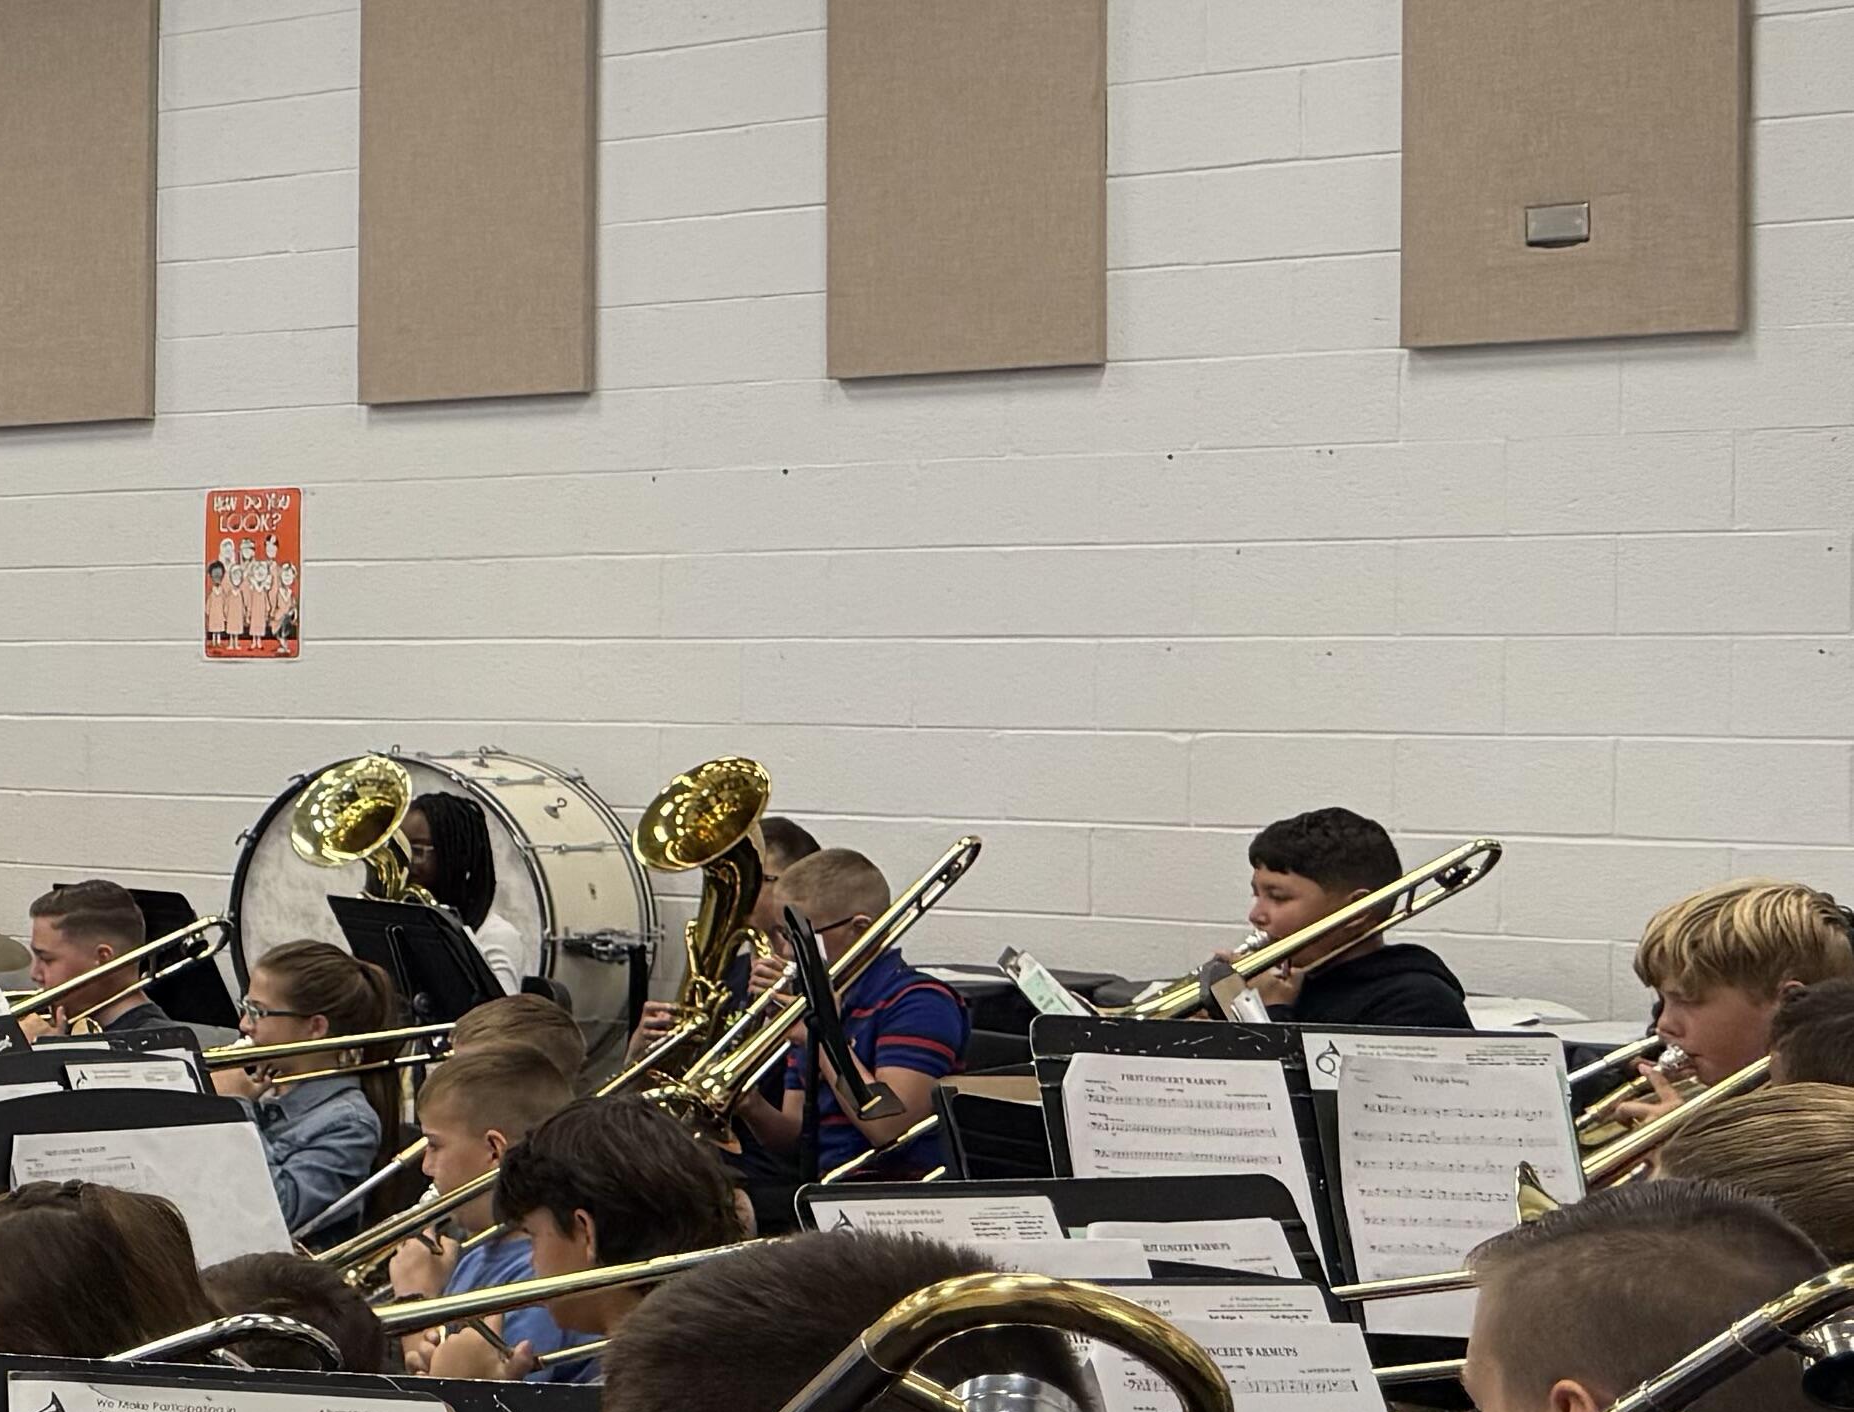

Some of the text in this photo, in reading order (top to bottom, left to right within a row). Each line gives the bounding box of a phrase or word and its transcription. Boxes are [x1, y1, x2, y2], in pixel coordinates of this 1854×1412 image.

[243, 494, 263, 511] DO
[266, 492, 291, 511] YOU
[219, 512, 282, 532] LOOK?
[1145, 1075, 1184, 1084] CONCERT
[1186, 1077, 1228, 1086] WARMUPS
[1246, 1347, 1299, 1357] WARMUPS
